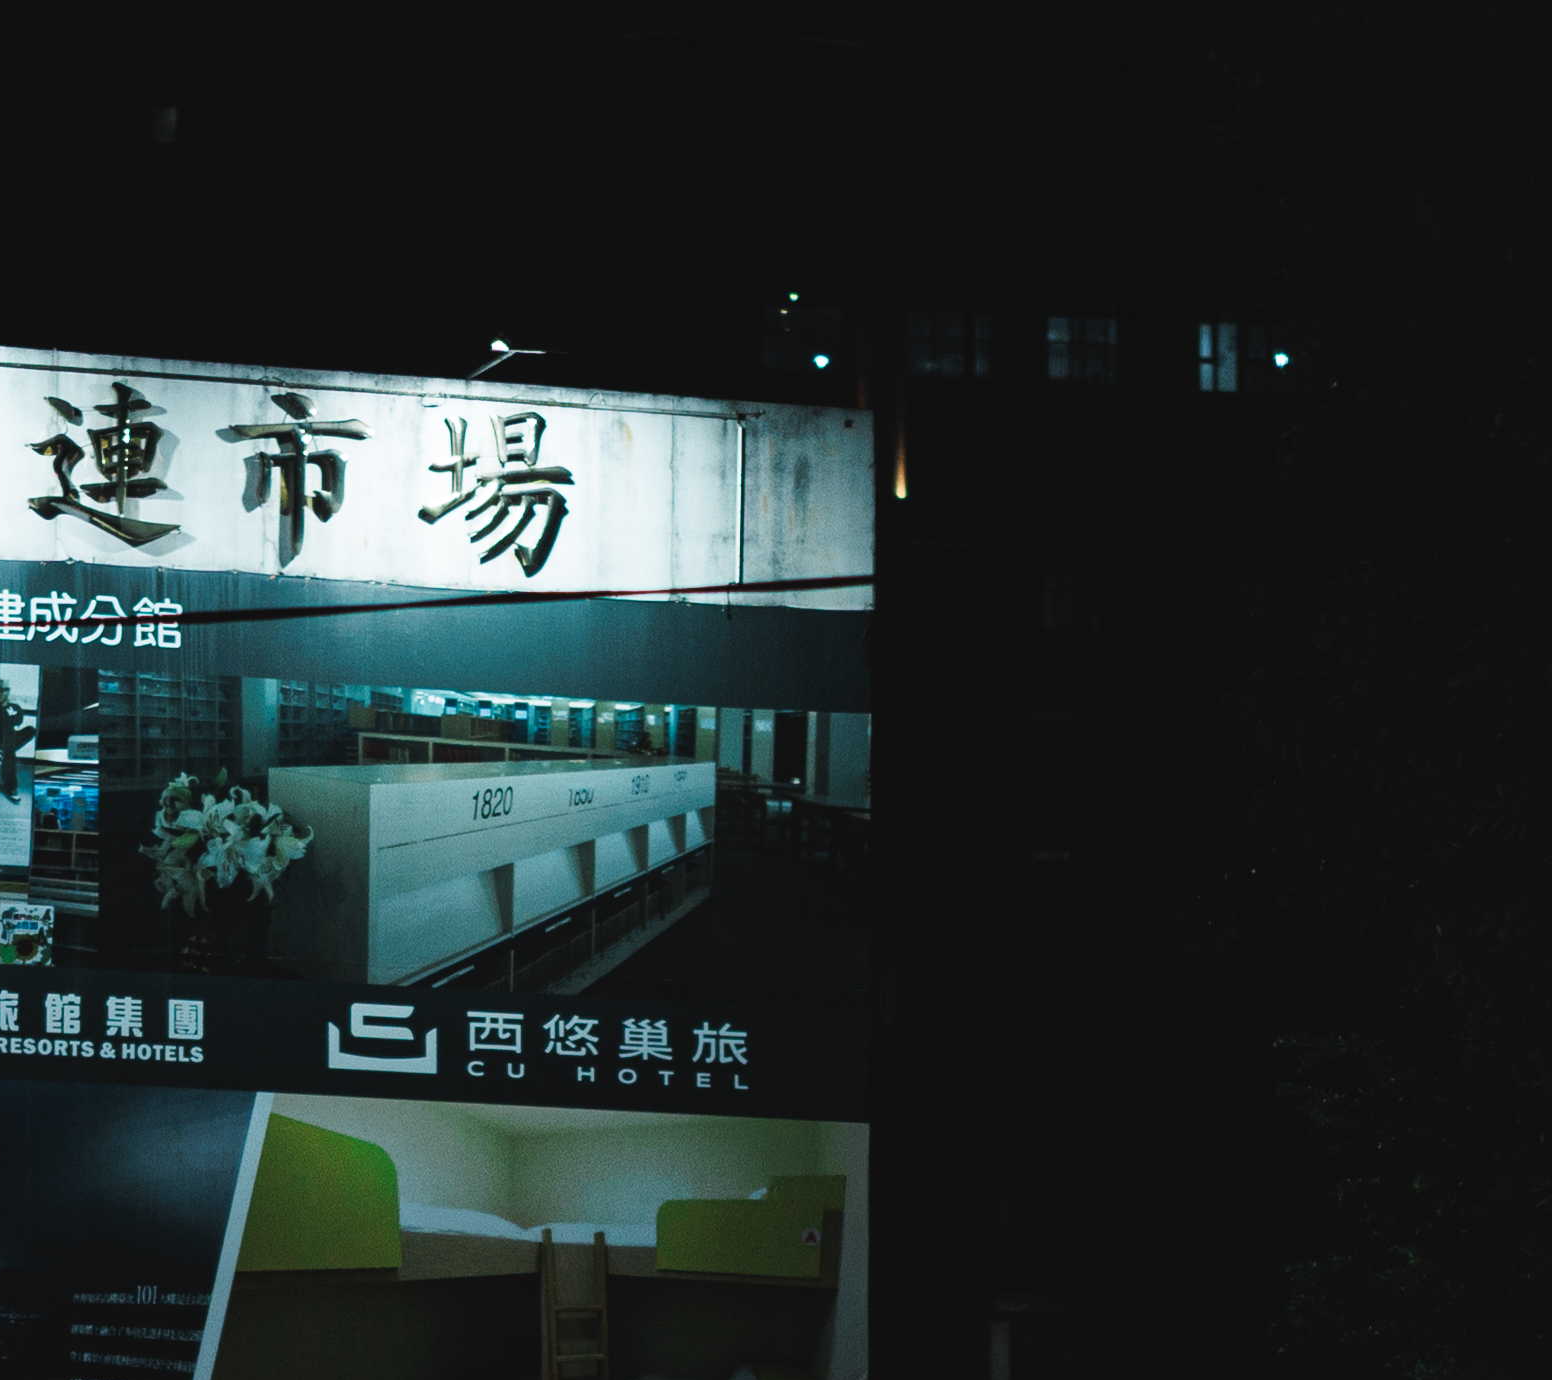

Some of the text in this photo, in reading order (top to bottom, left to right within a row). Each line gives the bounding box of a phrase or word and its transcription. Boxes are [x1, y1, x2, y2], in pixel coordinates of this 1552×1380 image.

[472, 786, 514, 820] 1820
[98, 1041, 116, 1059] &
[119, 1043, 205, 1064] HOTELS
[466, 1009, 749, 1067] 西悠巢旅
[466, 1059, 749, 1092] CU HOTEL
